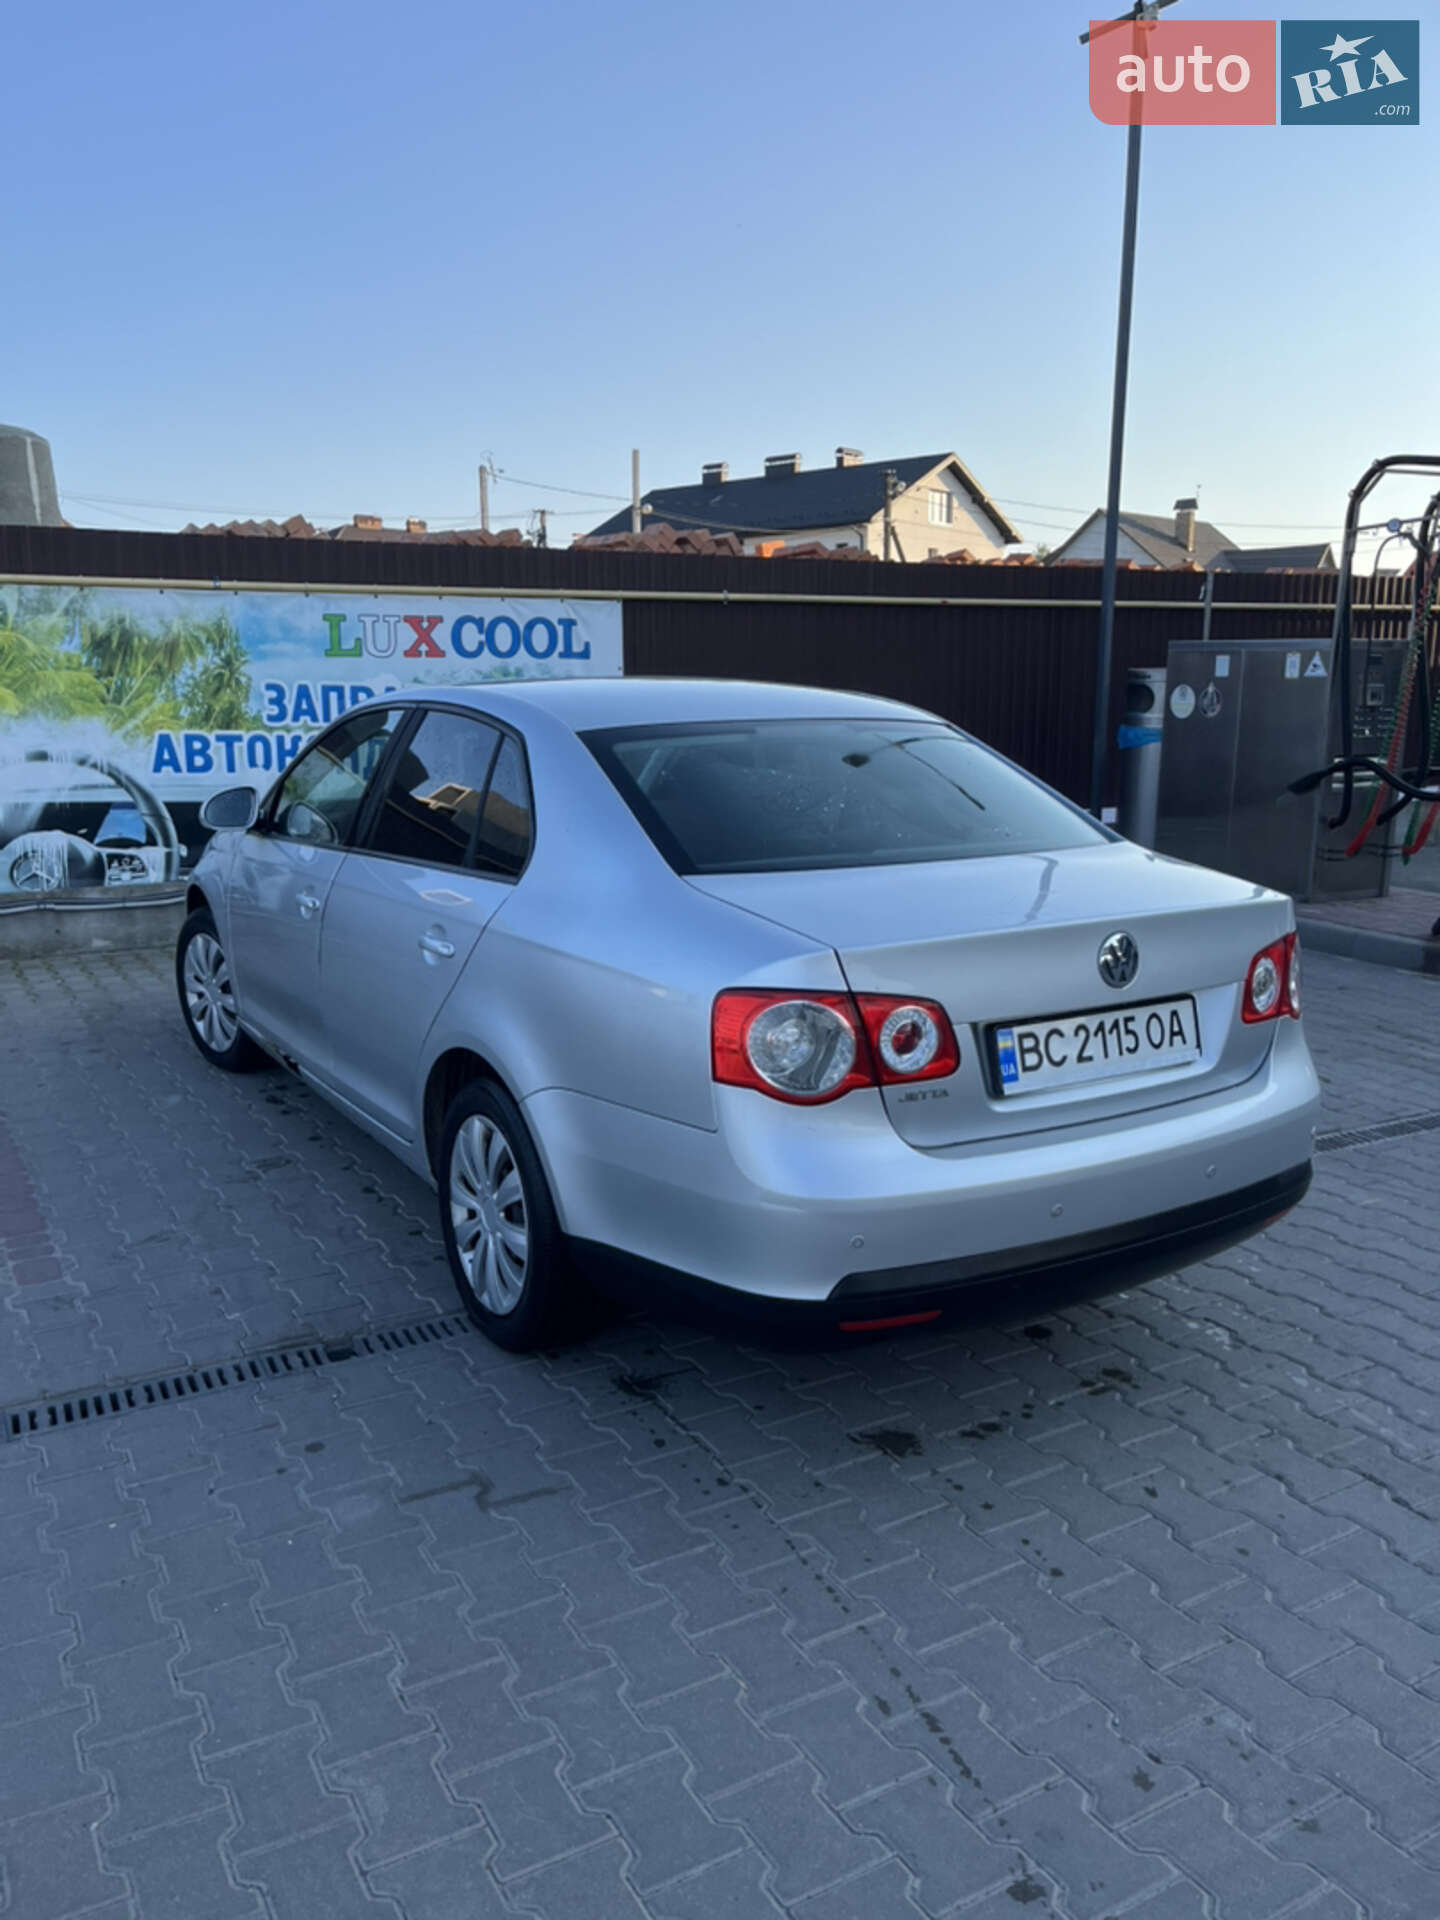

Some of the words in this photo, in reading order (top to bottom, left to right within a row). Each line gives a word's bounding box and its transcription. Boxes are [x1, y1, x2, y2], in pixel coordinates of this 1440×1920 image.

[264, 682, 396, 724] ЗАП
[152, 732, 318, 774] АВТОК
[1001, 1063, 1017, 1077] UA
